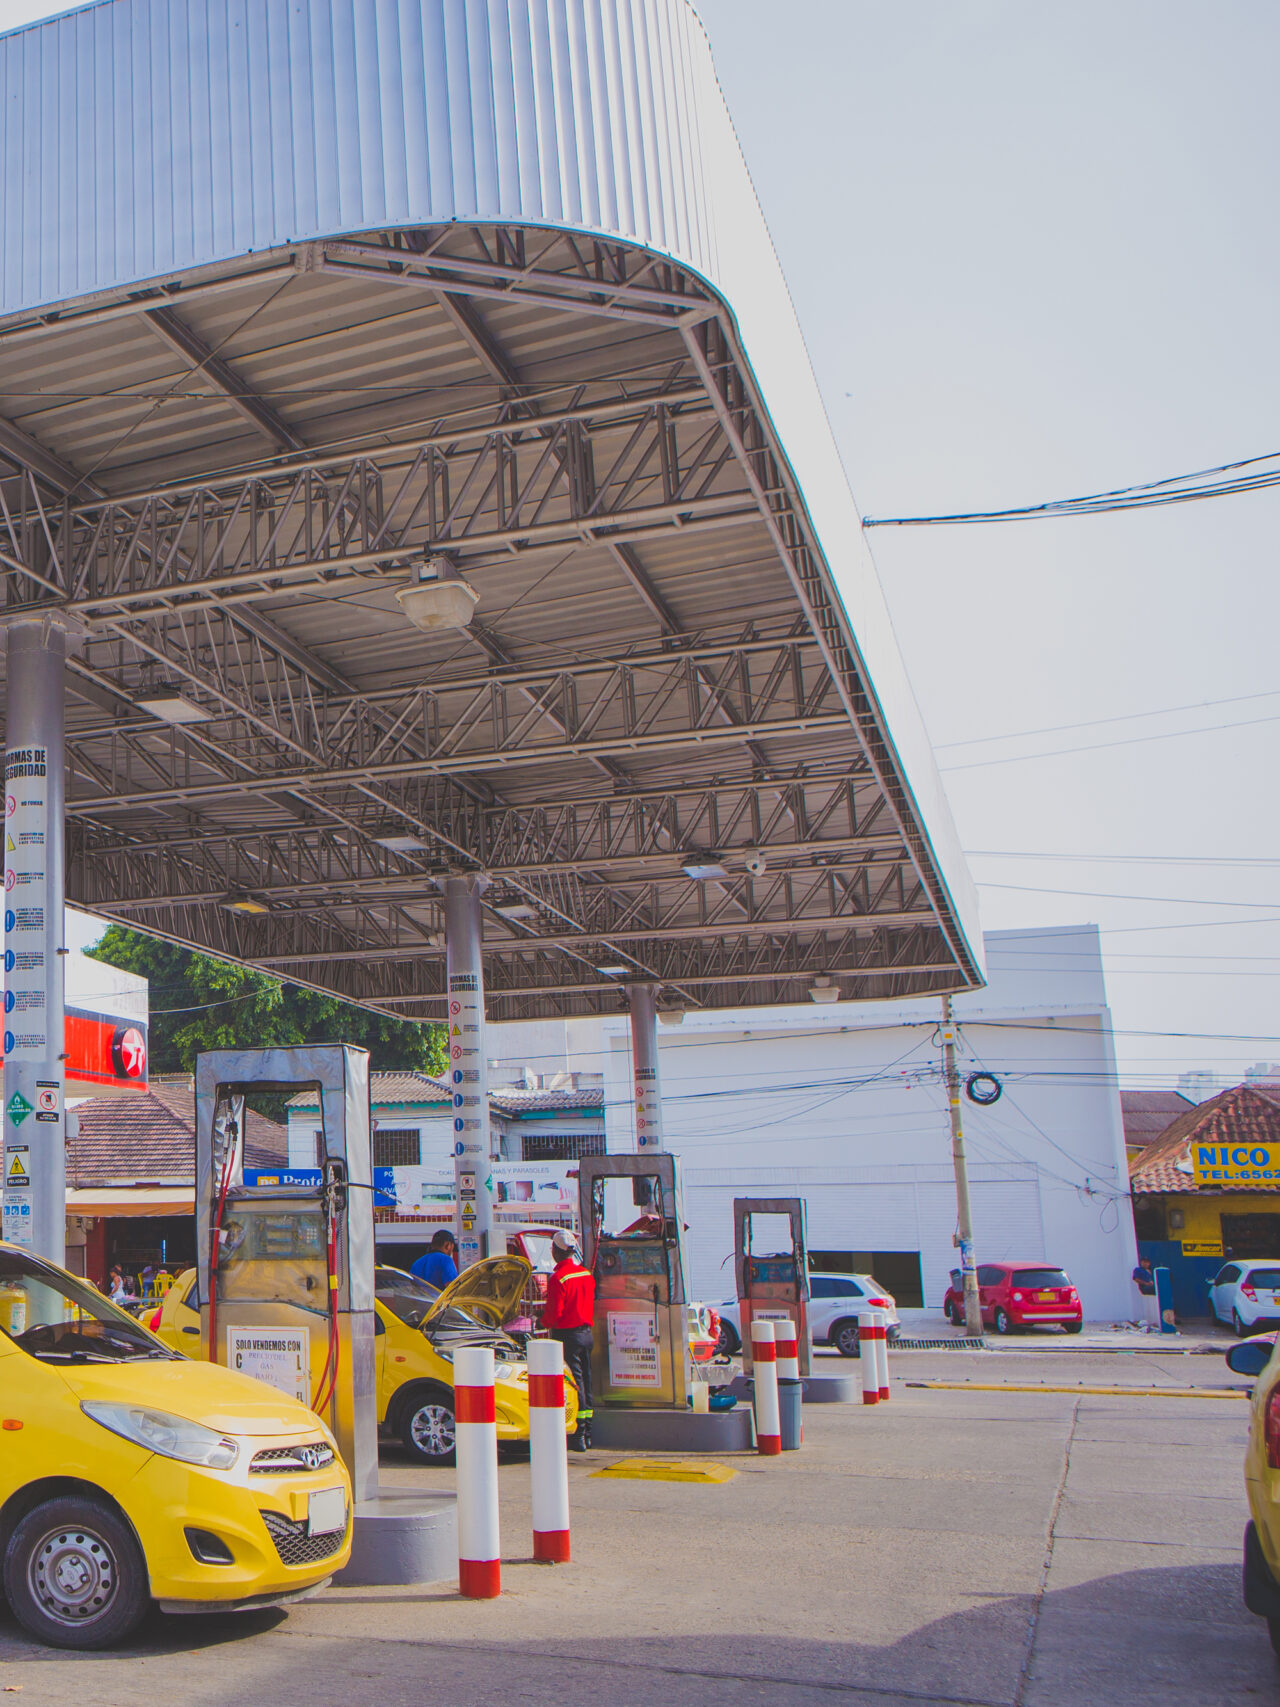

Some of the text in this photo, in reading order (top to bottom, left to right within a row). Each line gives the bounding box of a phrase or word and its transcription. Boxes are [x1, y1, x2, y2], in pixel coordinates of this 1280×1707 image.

[34, 750, 46, 763] DE
[1197, 1147, 1271, 1167] NICO
[236, 1339, 301, 1351] SOLO VENDEMOS CON
[260, 1362, 274, 1370] GAS
